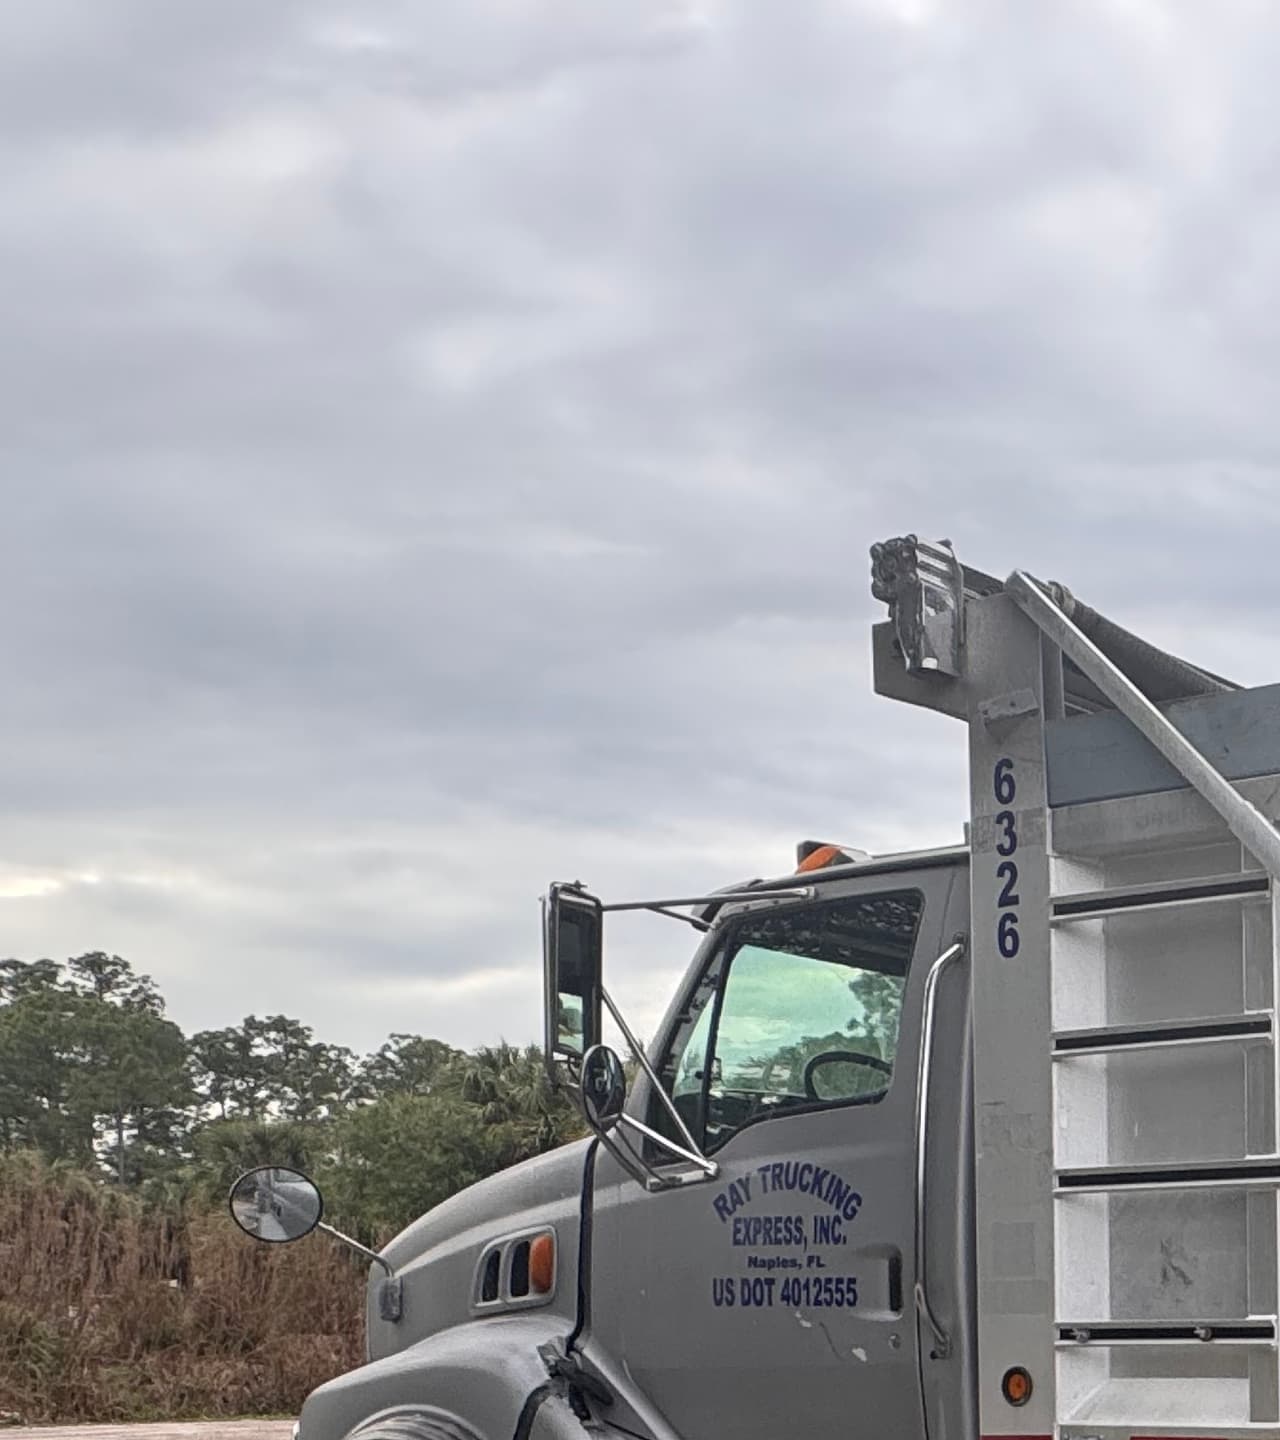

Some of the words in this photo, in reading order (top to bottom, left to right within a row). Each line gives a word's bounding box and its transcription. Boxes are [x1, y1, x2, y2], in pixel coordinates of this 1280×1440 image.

[993, 757, 1021, 959] 6326
[713, 1175, 751, 1224] RAY
[757, 1161, 862, 1221] TRUCKING
[732, 1216, 807, 1252] EXPRESS,
[813, 1215, 847, 1245] INC.
[747, 1255, 803, 1271] Naples,
[806, 1255, 826, 1269] FL
[713, 1277, 735, 1307] US
[740, 1277, 776, 1307] DOT
[780, 1277, 858, 1307] 4012555
